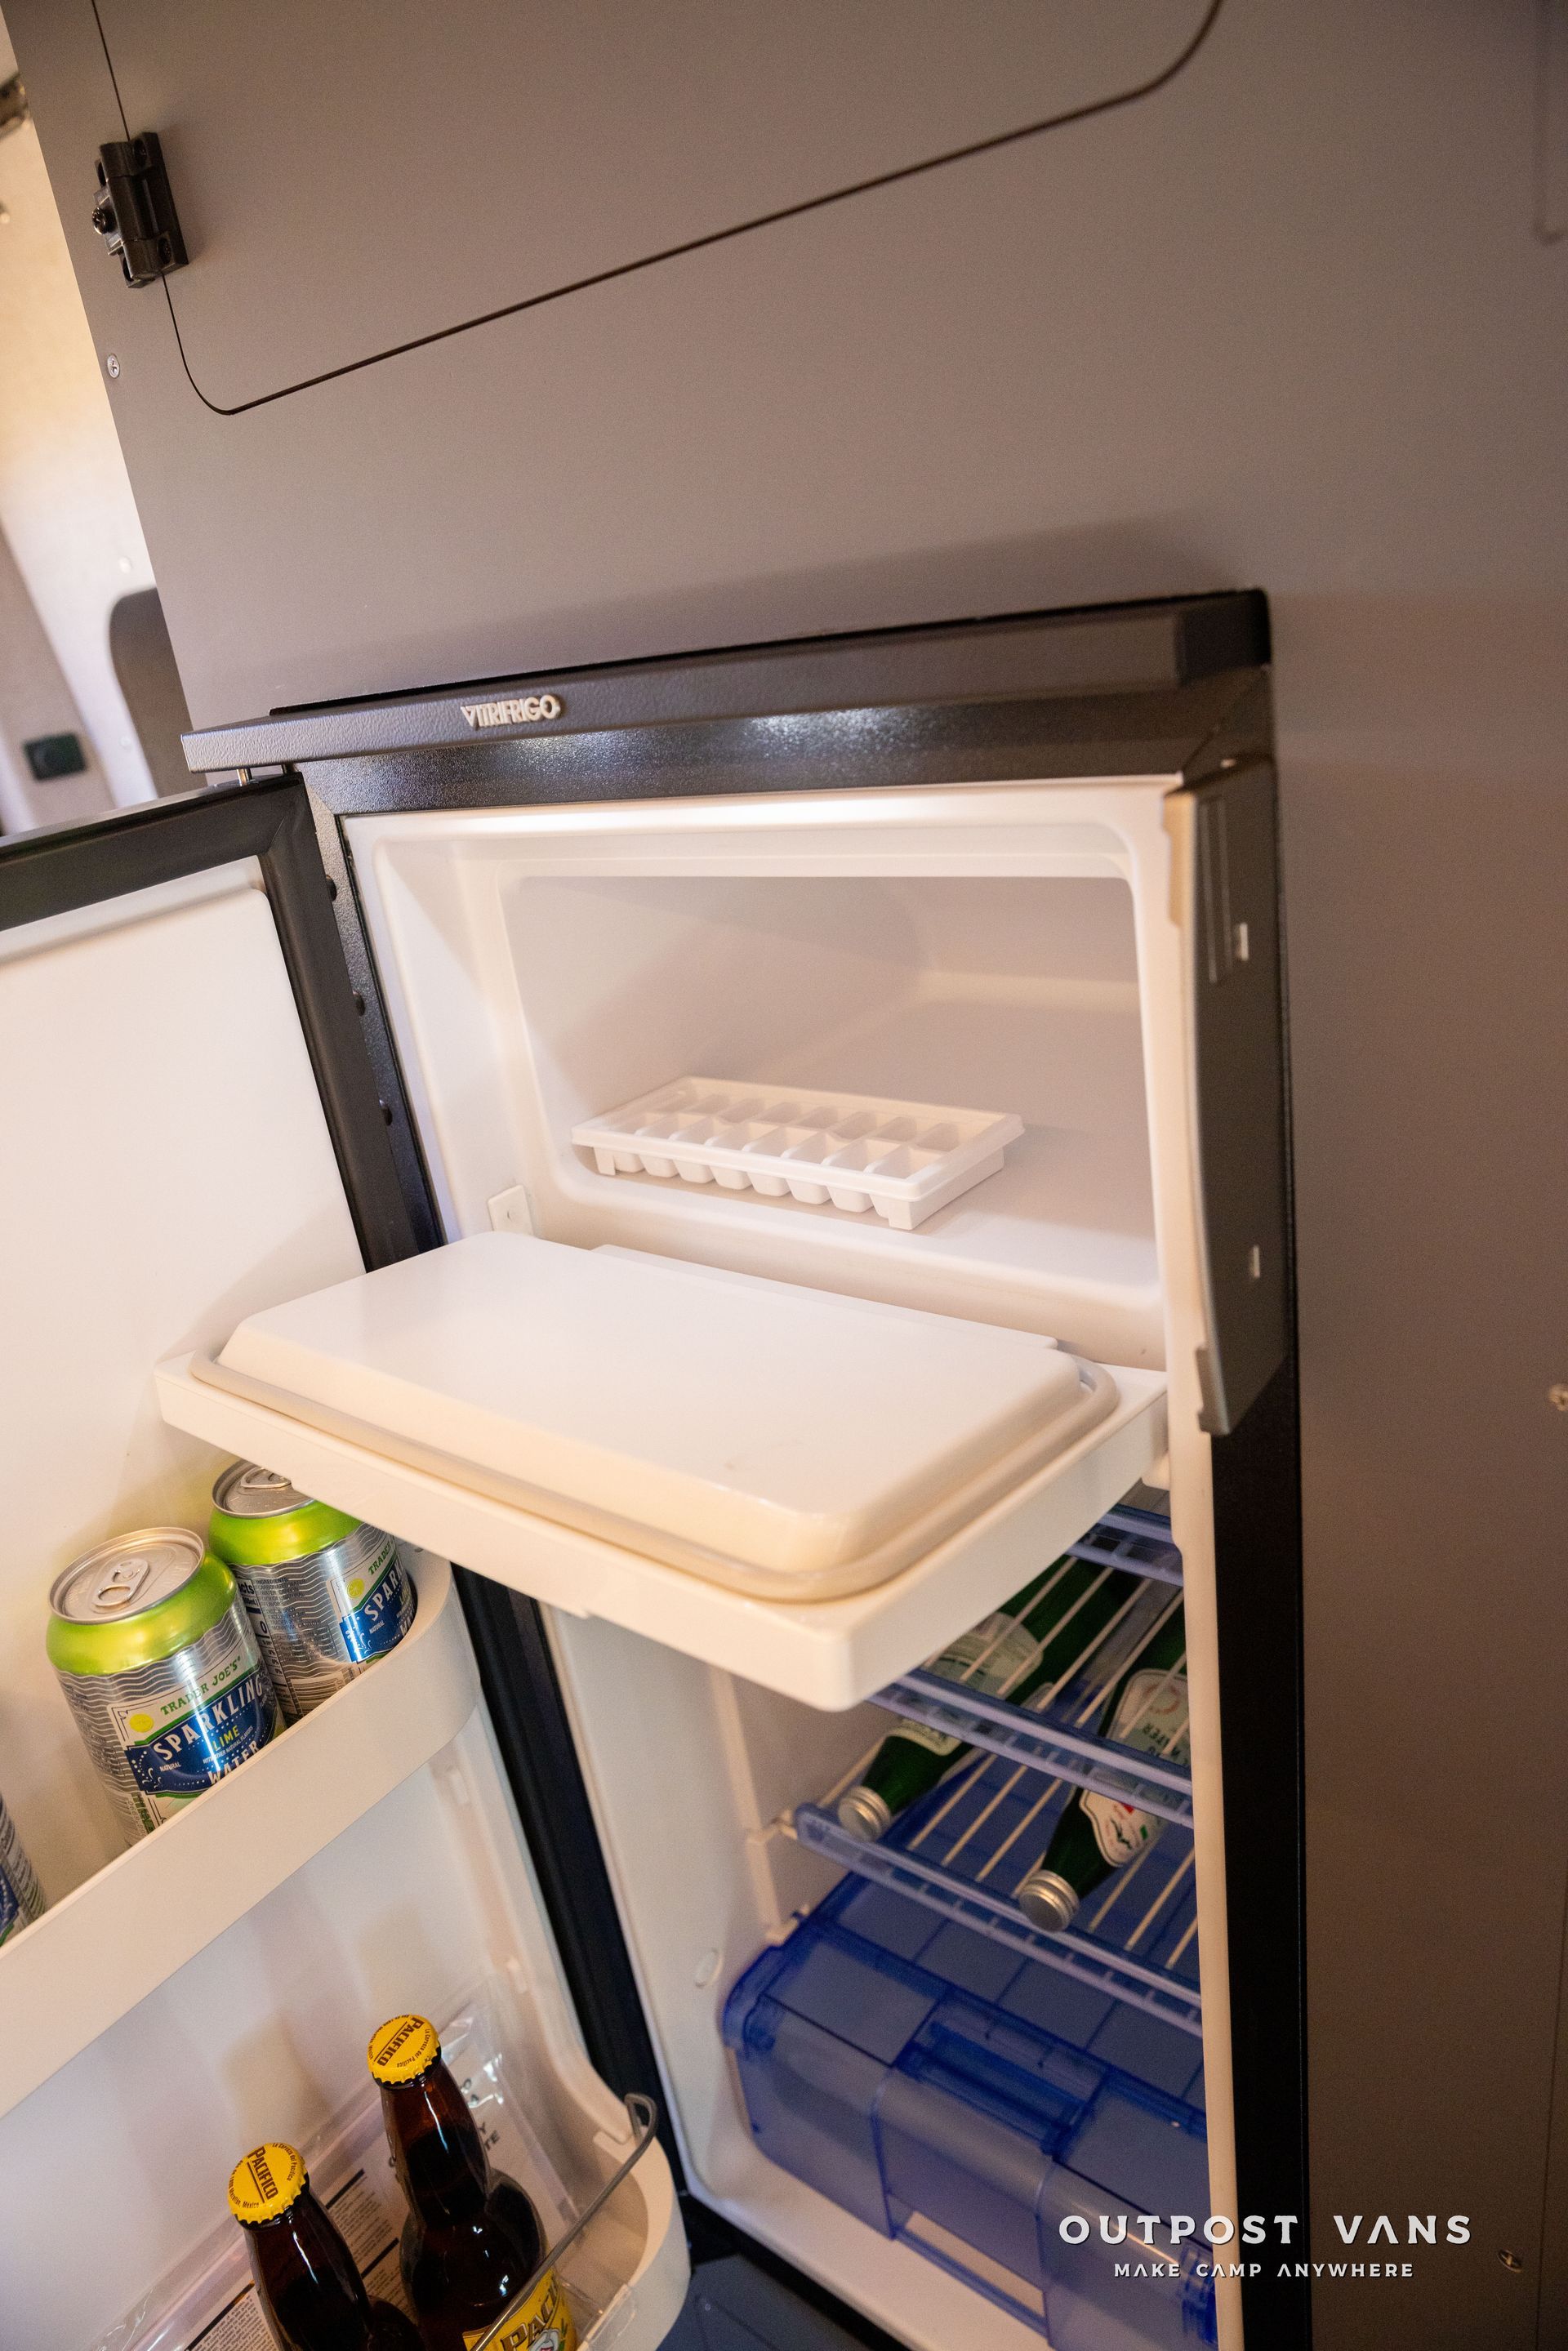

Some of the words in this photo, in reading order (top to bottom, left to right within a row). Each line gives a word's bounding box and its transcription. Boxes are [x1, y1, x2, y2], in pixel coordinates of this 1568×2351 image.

[460, 694, 561, 728] VITRIFRIGO
[364, 1557, 403, 1622] SPARK
[154, 1673, 263, 1761] SPARKLING
[160, 1683, 209, 1716] TRADER
[212, 1725, 240, 1752] LIME
[159, 1761, 181, 1772] NATURAL
[207, 1740, 260, 1785] WATER
[376, 2017, 425, 2067] PACIFICO
[247, 2146, 278, 2200] PACIFICO
